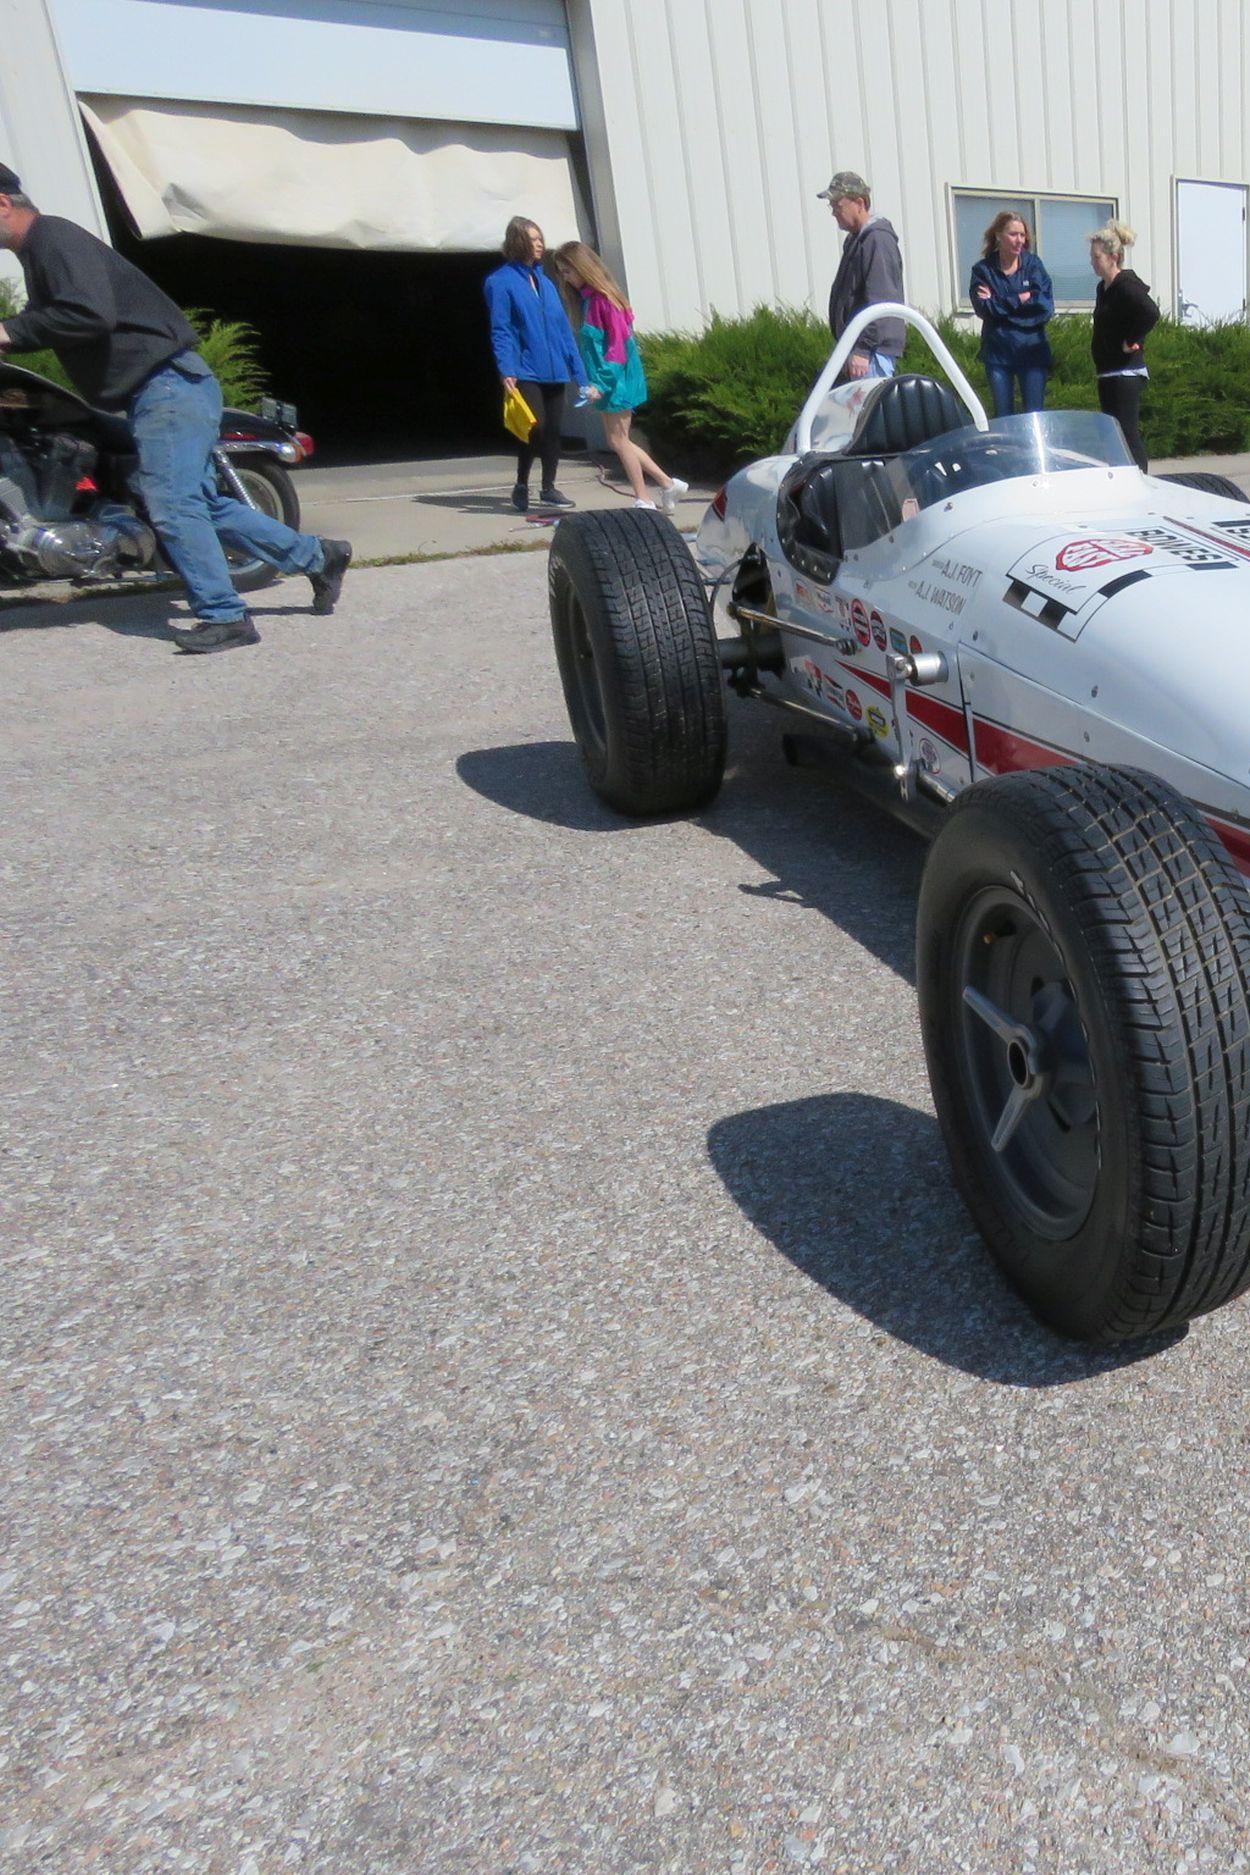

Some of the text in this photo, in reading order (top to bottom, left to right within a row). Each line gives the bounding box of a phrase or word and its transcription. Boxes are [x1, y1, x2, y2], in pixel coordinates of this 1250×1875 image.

[1125, 528, 1224, 561] BOWES
[957, 564, 983, 588] FOYT
[1025, 564, 1088, 595] Special
[930, 586, 967, 616] WATSON
